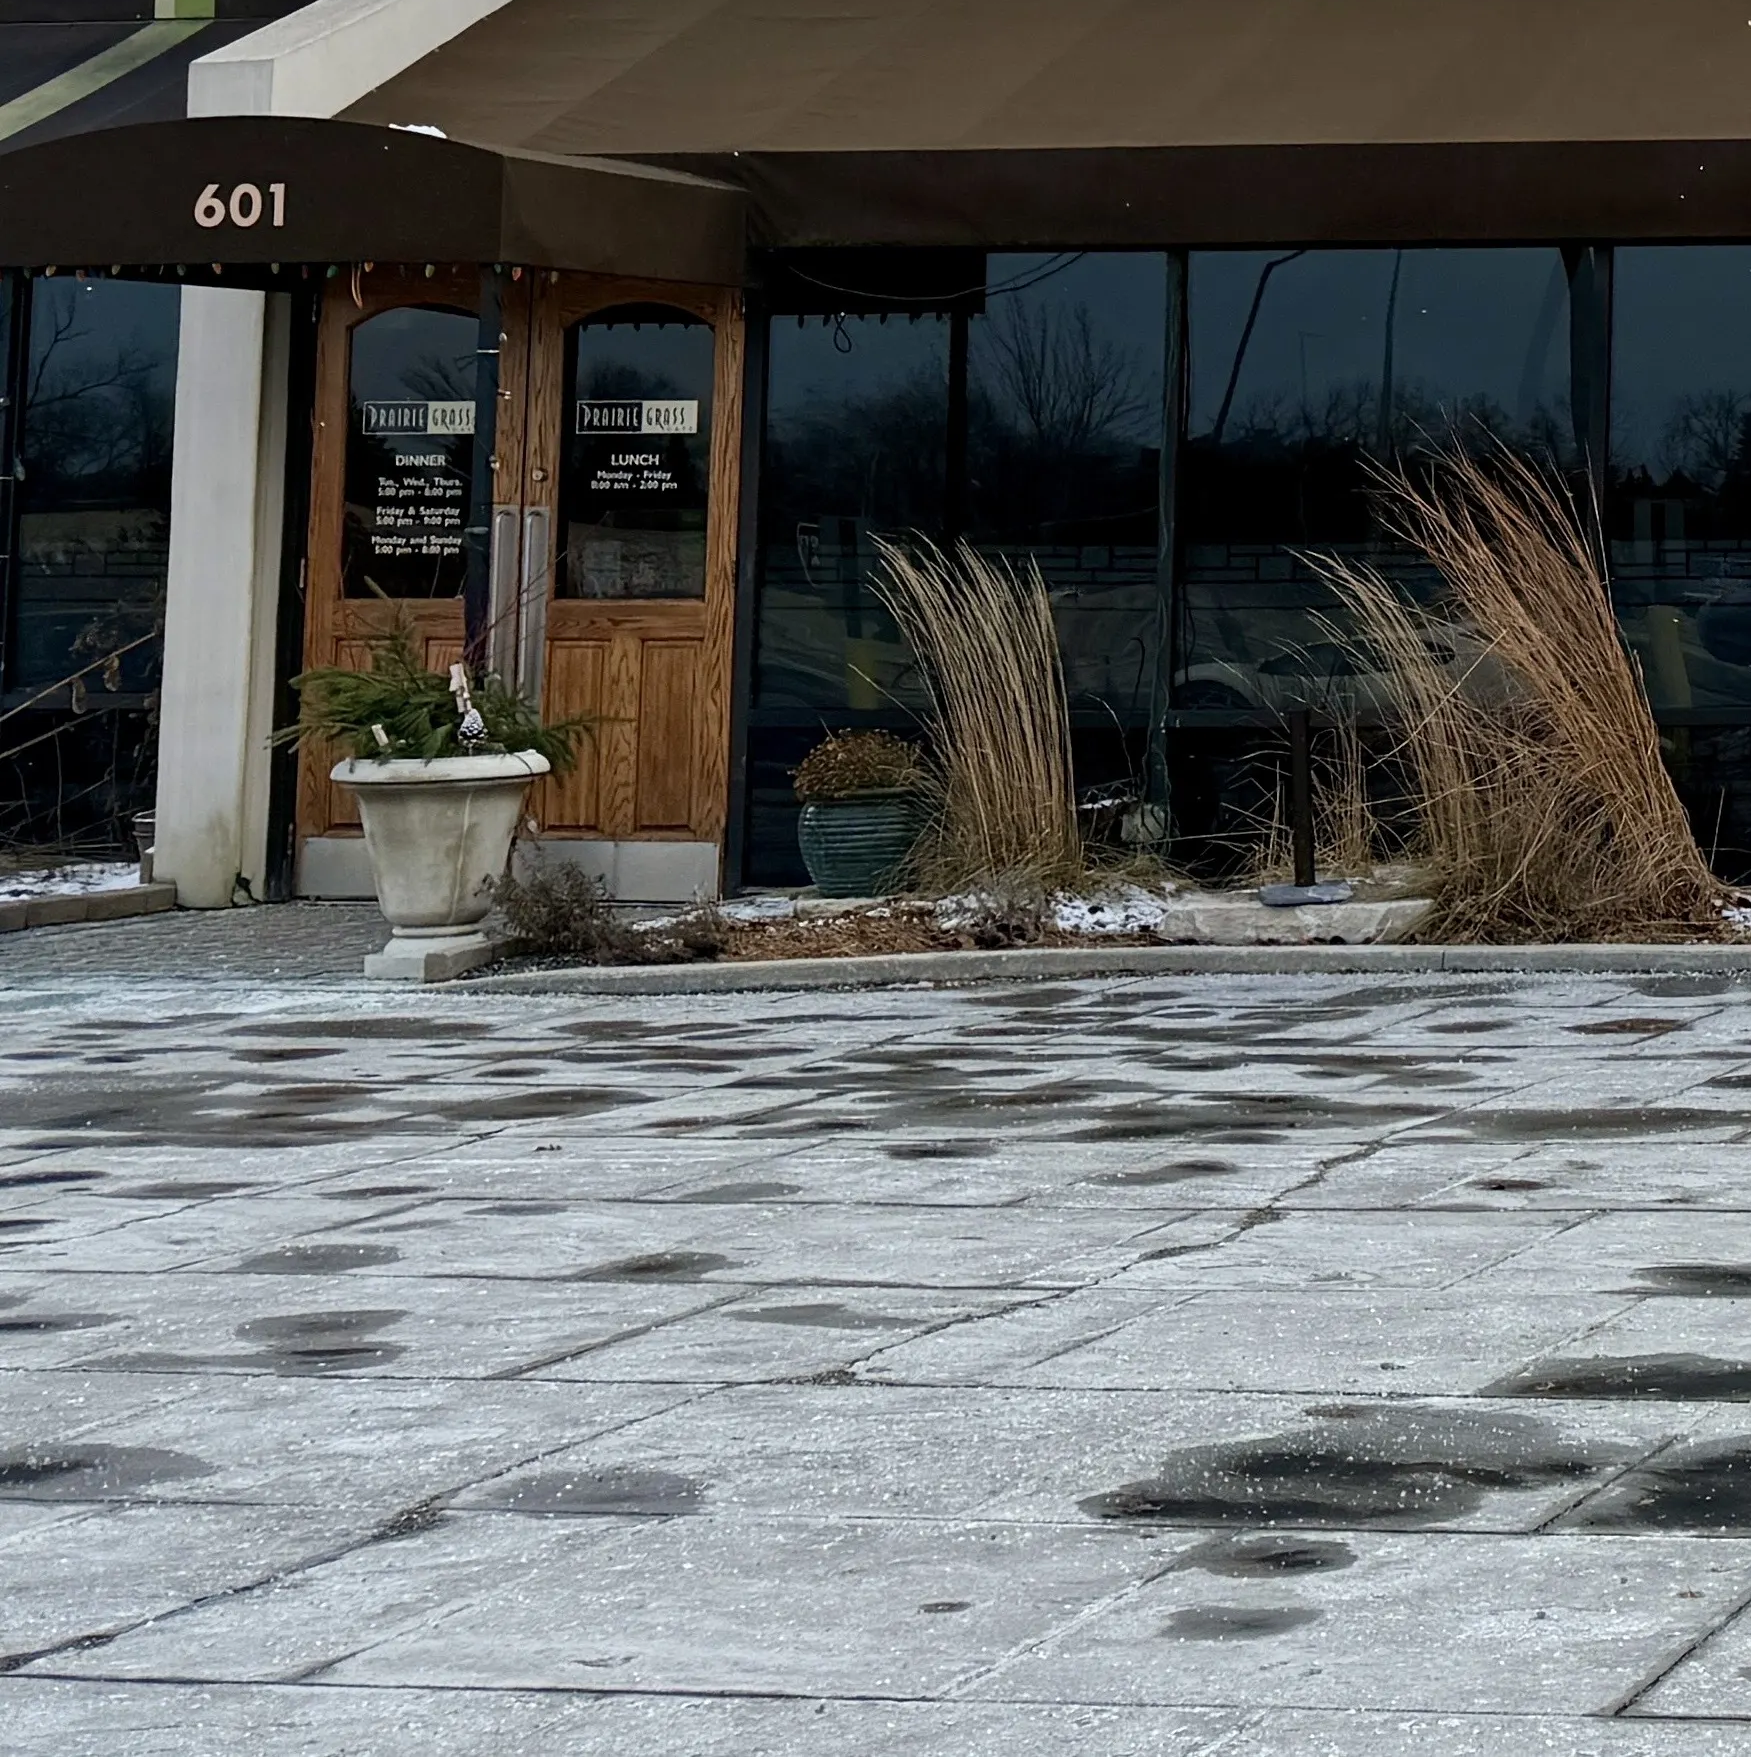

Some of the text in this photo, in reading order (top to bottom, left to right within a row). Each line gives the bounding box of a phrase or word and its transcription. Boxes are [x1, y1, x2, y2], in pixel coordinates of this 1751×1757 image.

[194, 183, 285, 227] 601
[367, 404, 470, 431] PRAIRIE GRASS
[581, 404, 685, 430] PRAIRIE GRASS
[395, 454, 446, 467] DINNER
[611, 454, 659, 466] LUNCH
[597, 470, 633, 481] Monday
[643, 470, 672, 481] Friday
[661, 482, 678, 491] pm
[399, 489, 415, 498] pm
[445, 489, 462, 498] pm
[376, 506, 405, 517] Friday
[419, 506, 460, 517] Saturday
[397, 518, 413, 527] pm
[444, 518, 461, 527] pm
[371, 535, 462, 546] Monday and Sunday
[396, 547, 412, 556] pm
[443, 547, 460, 556] pm
